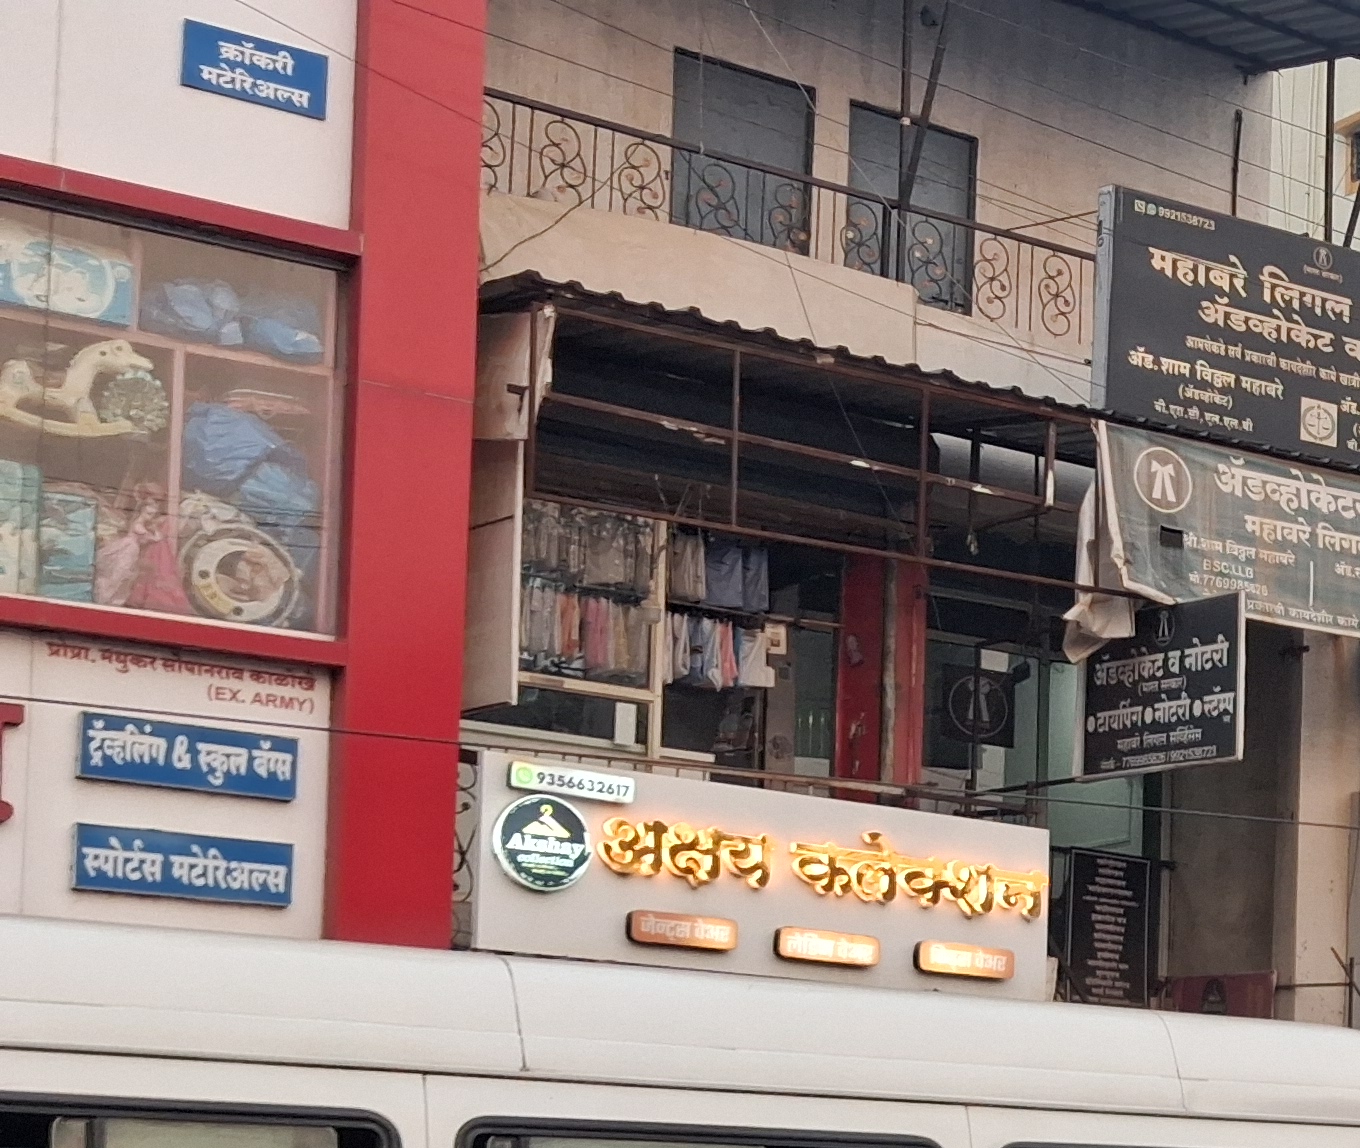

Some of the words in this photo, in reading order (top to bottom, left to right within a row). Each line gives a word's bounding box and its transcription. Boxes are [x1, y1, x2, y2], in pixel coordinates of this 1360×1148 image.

[217, 40, 295, 76] क्रॉकरी
[198, 62, 311, 108] मटेरिअल्स
[1258, 264, 1354, 324] लिगल
[1167, 649, 1181, 674] व
[1183, 633, 1230, 672] नोटरी
[251, 690, 315, 715] ARMY)
[536, 771, 630, 797] 9356632617
[504, 831, 585, 861] Akshay
[169, 844, 288, 895] मटेरिअल्स
[594, 815, 774, 890] अक्षय
[788, 830, 1051, 922] कलेक्शन
